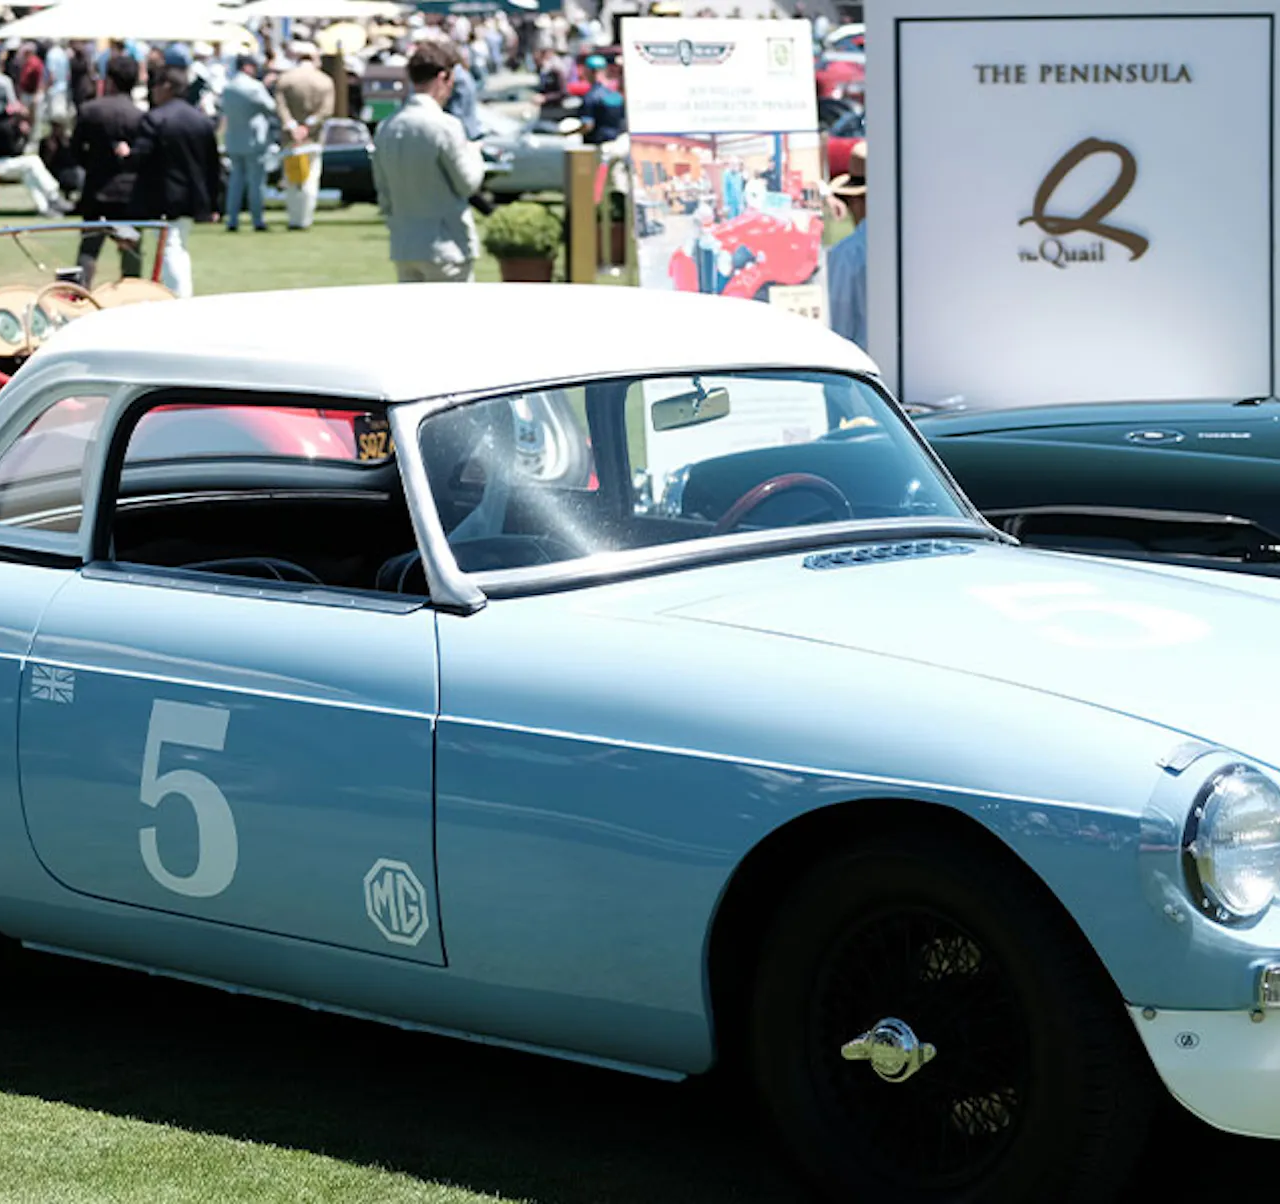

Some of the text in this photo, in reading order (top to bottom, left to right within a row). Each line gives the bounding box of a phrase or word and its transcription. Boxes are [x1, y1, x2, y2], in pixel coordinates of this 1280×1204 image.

[972, 63, 1193, 85] THE PENINSULA
[1018, 136, 1150, 262] Q
[1039, 237, 1105, 270] Quail
[965, 580, 1214, 650] 5
[139, 698, 239, 898] 5
[371, 869, 423, 935] MG
